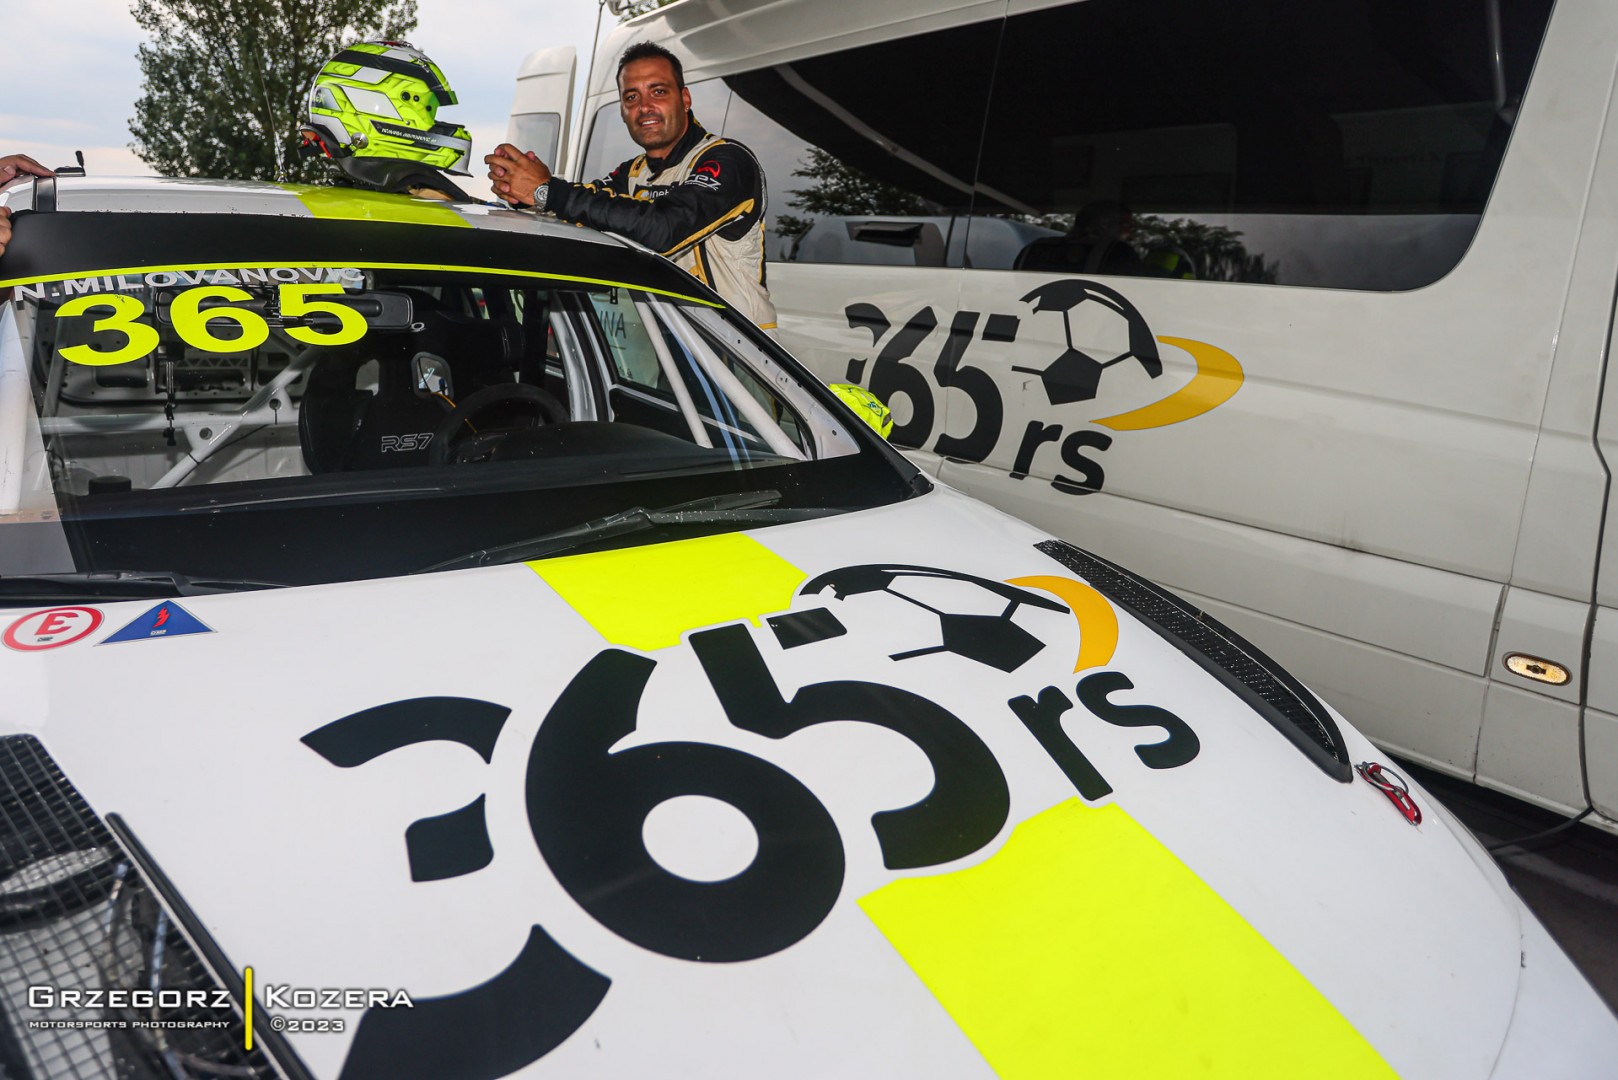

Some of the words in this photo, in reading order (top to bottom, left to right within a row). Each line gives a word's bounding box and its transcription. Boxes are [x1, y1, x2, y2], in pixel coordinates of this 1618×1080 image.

[54, 283, 368, 367] 365
[381, 433, 434, 452] RS7
[1009, 420, 1112, 495] rs
[1008, 671, 1201, 801] rs
